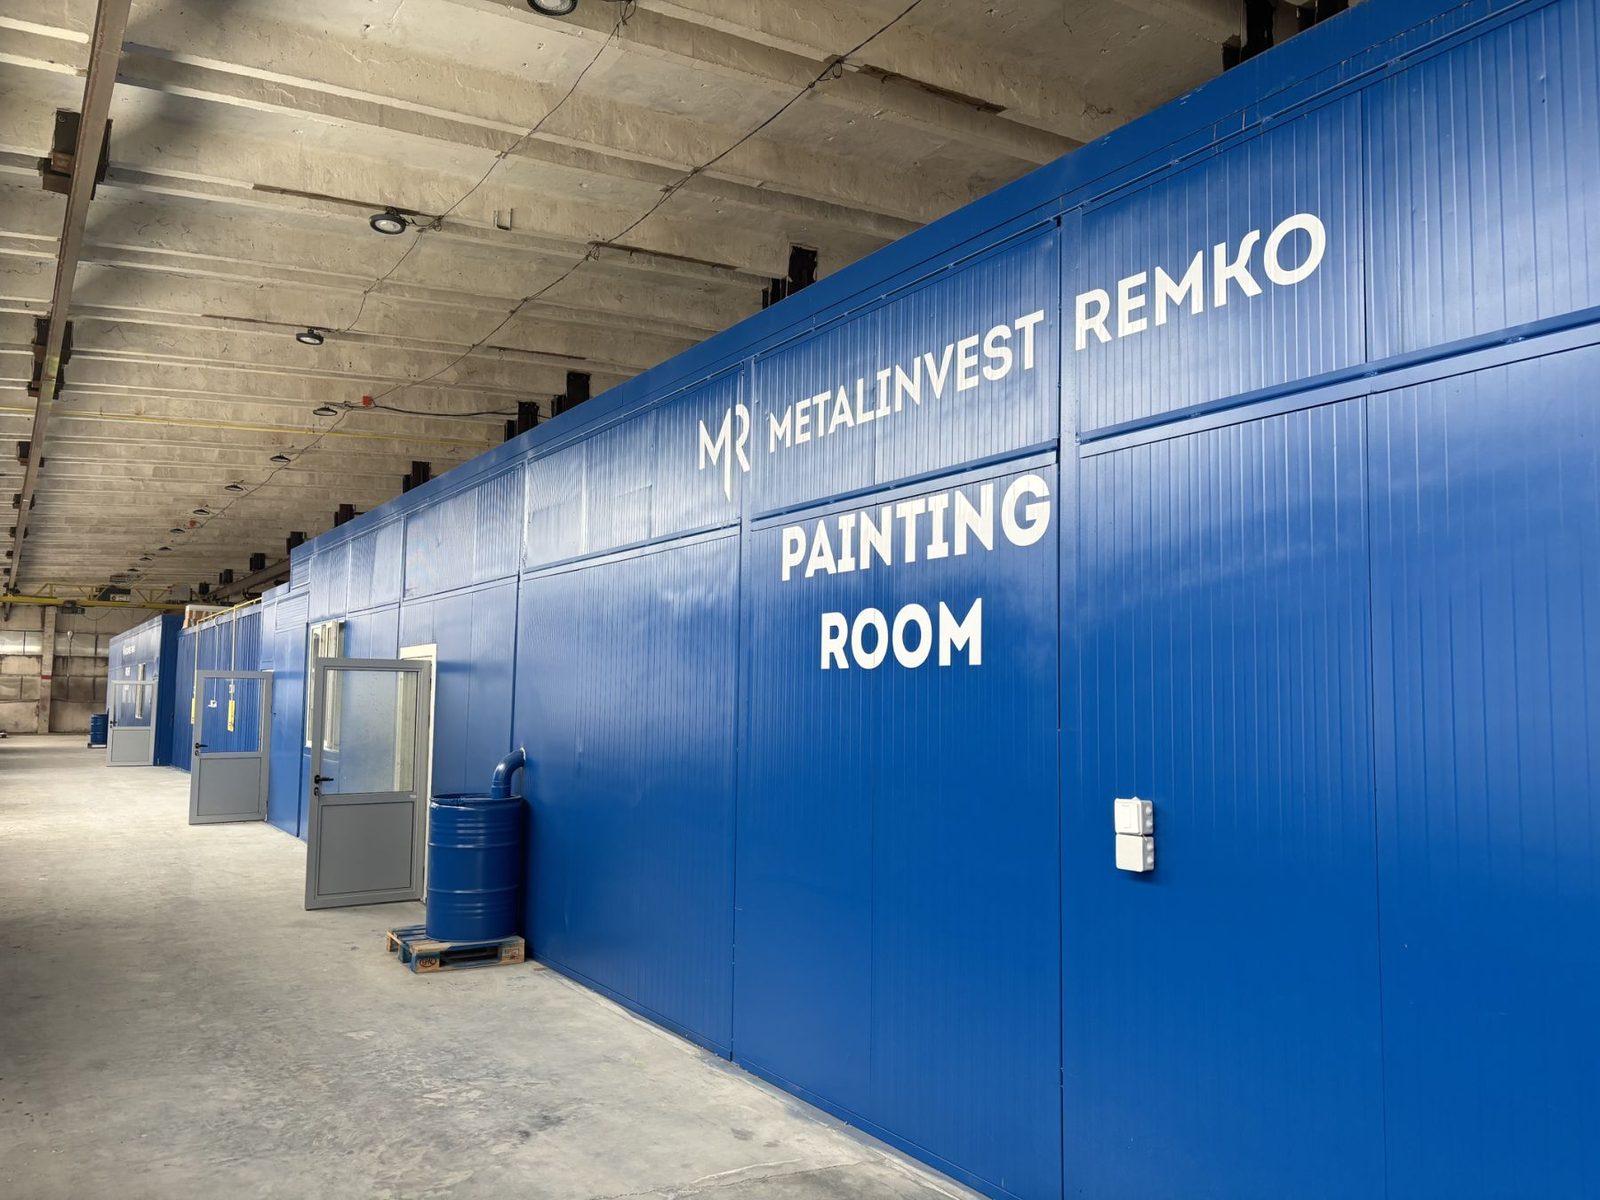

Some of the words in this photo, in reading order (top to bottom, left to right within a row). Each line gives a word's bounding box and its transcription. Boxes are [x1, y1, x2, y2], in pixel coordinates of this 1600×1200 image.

[768, 309, 1046, 454] METALINVEST
[1074, 213, 1327, 352] REMKO
[780, 474, 1052, 583] PAINTING
[820, 598, 983, 671] ROOM
